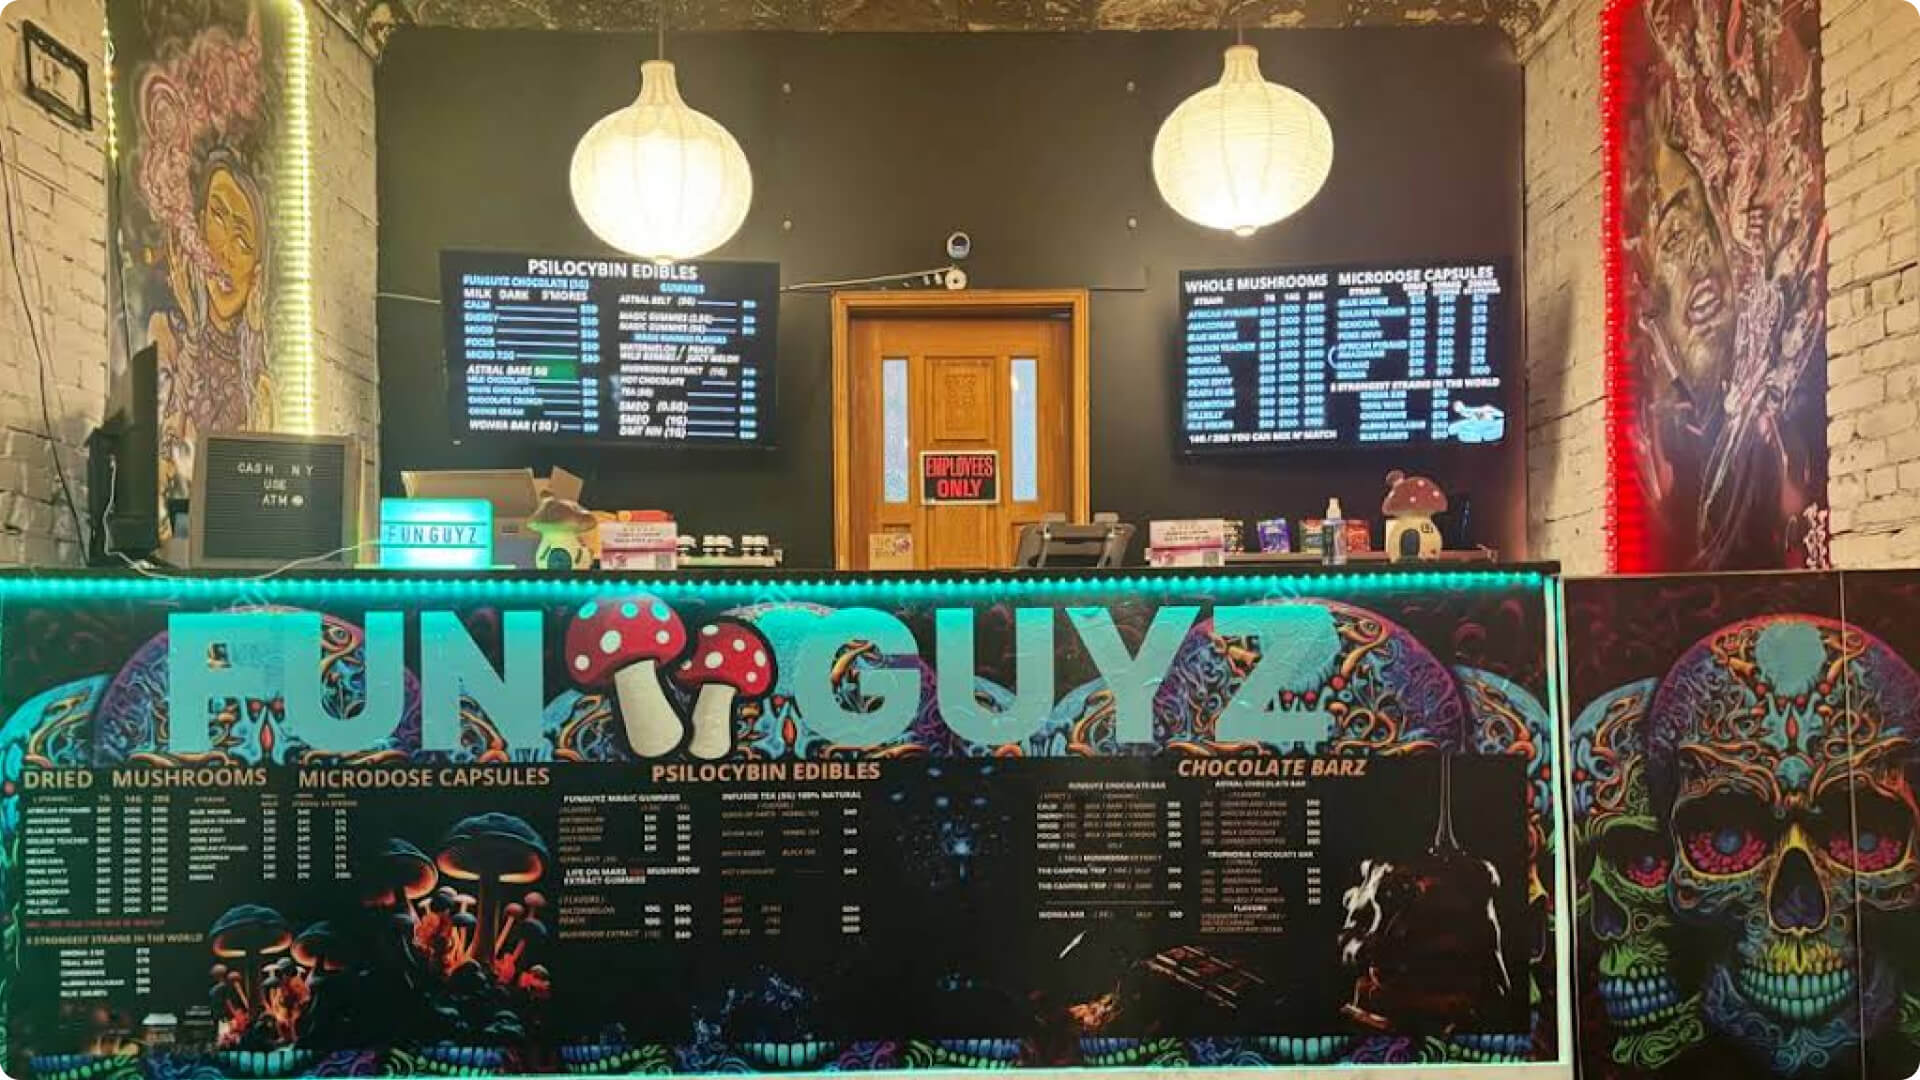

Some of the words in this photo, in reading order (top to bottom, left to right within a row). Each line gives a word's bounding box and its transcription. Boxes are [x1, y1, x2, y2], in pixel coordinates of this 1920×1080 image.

[528, 259, 627, 278] PSILOCYBIN
[632, 263, 698, 281] EDIBLES
[1338, 269, 1421, 286] MICRODOSE
[1424, 266, 1495, 282] CAPSULES
[511, 276, 568, 289] CHOCOLATE
[1185, 277, 1235, 293] WHOLE
[1238, 273, 1328, 290] MUSHROOMS
[463, 288, 492, 300] MILK
[237, 462, 274, 475] CASH
[925, 457, 993, 478] EMPLOYEES
[263, 480, 286, 490] USE
[936, 479, 982, 498] ONLY
[262, 495, 288, 507] ATM
[168, 611, 543, 753] FUN
[800, 605, 1335, 748] GUYZ
[652, 763, 786, 782] PSILOCYBIN
[794, 761, 881, 780] EDIBLES
[1177, 759, 1305, 777] CHOCOLATE
[1310, 758, 1368, 777] BARZ
[24, 769, 94, 790] DRIED
[112, 767, 267, 789] MUSHROOMS
[299, 768, 433, 789] MICRODOSE
[439, 767, 550, 787] CAPSULES
[821, 790, 862, 800] NATURAL
